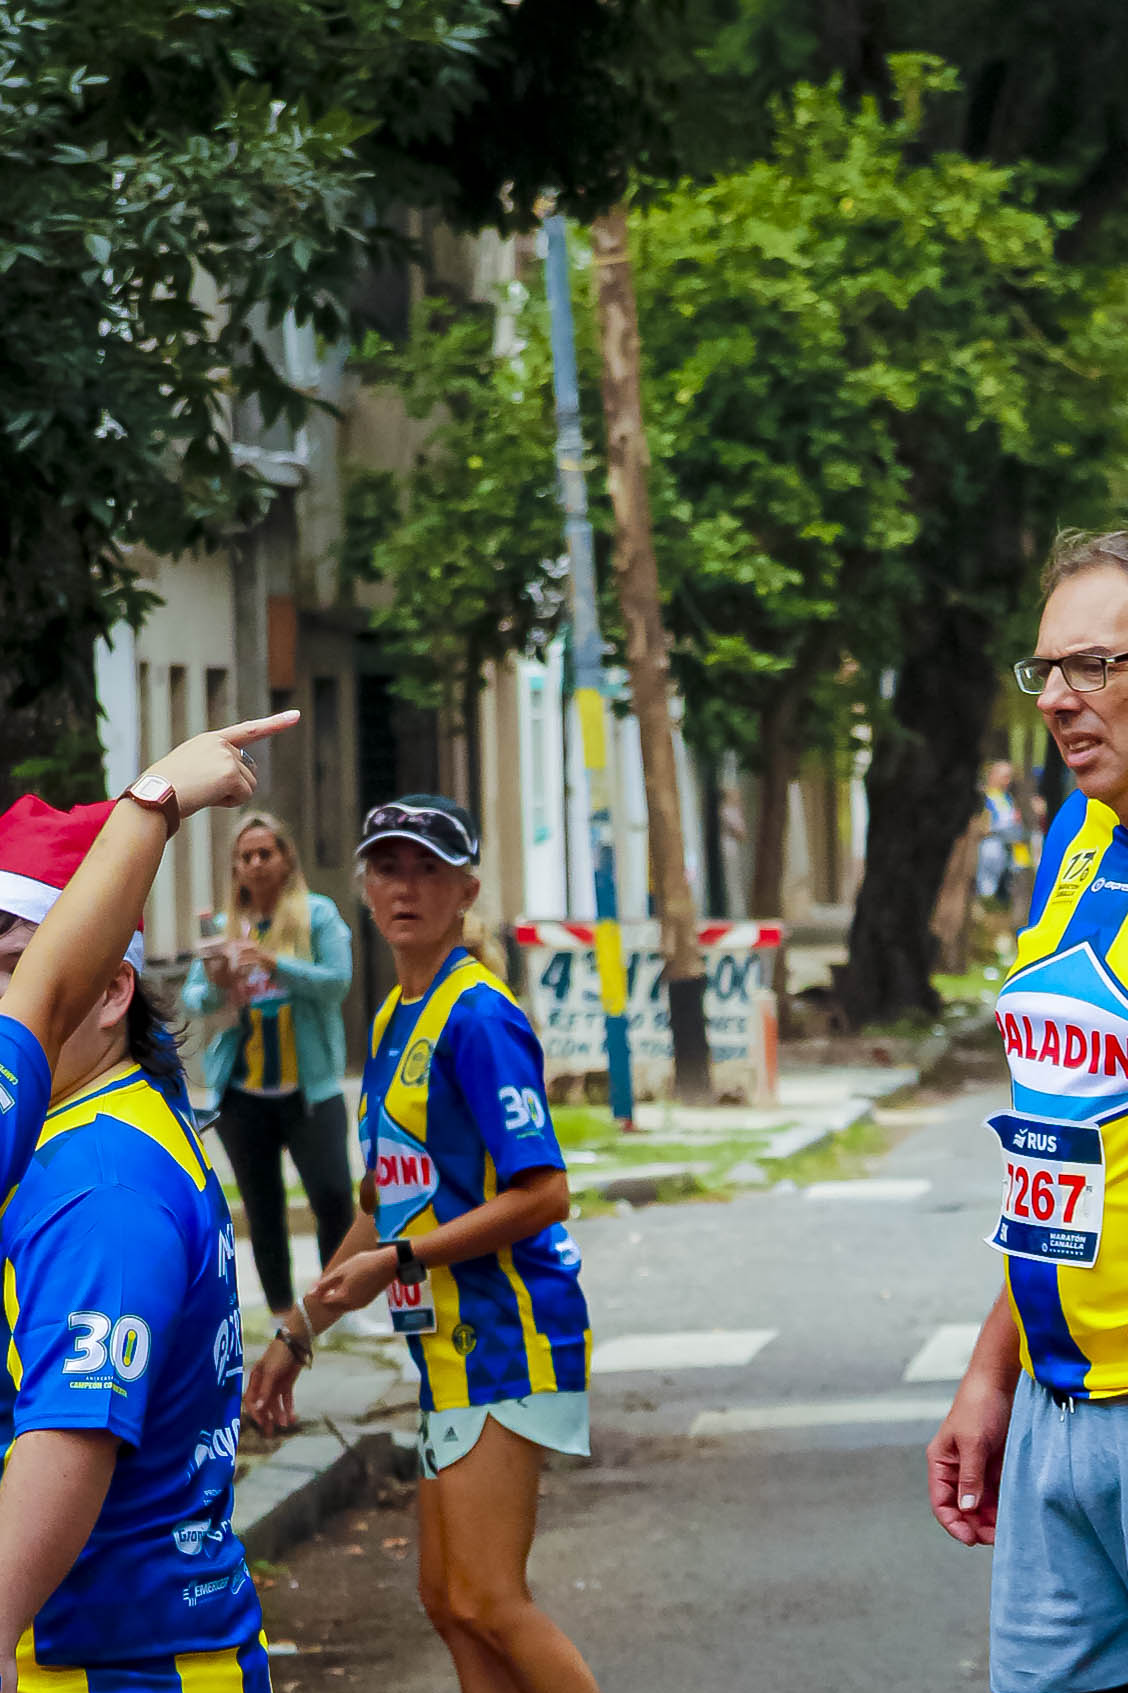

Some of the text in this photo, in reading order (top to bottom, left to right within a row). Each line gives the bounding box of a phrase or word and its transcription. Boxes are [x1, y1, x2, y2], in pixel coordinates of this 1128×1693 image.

[499, 1086, 546, 1131] 30
[1027, 1132, 1058, 1153] RUS
[62, 1311, 151, 1382] 30
